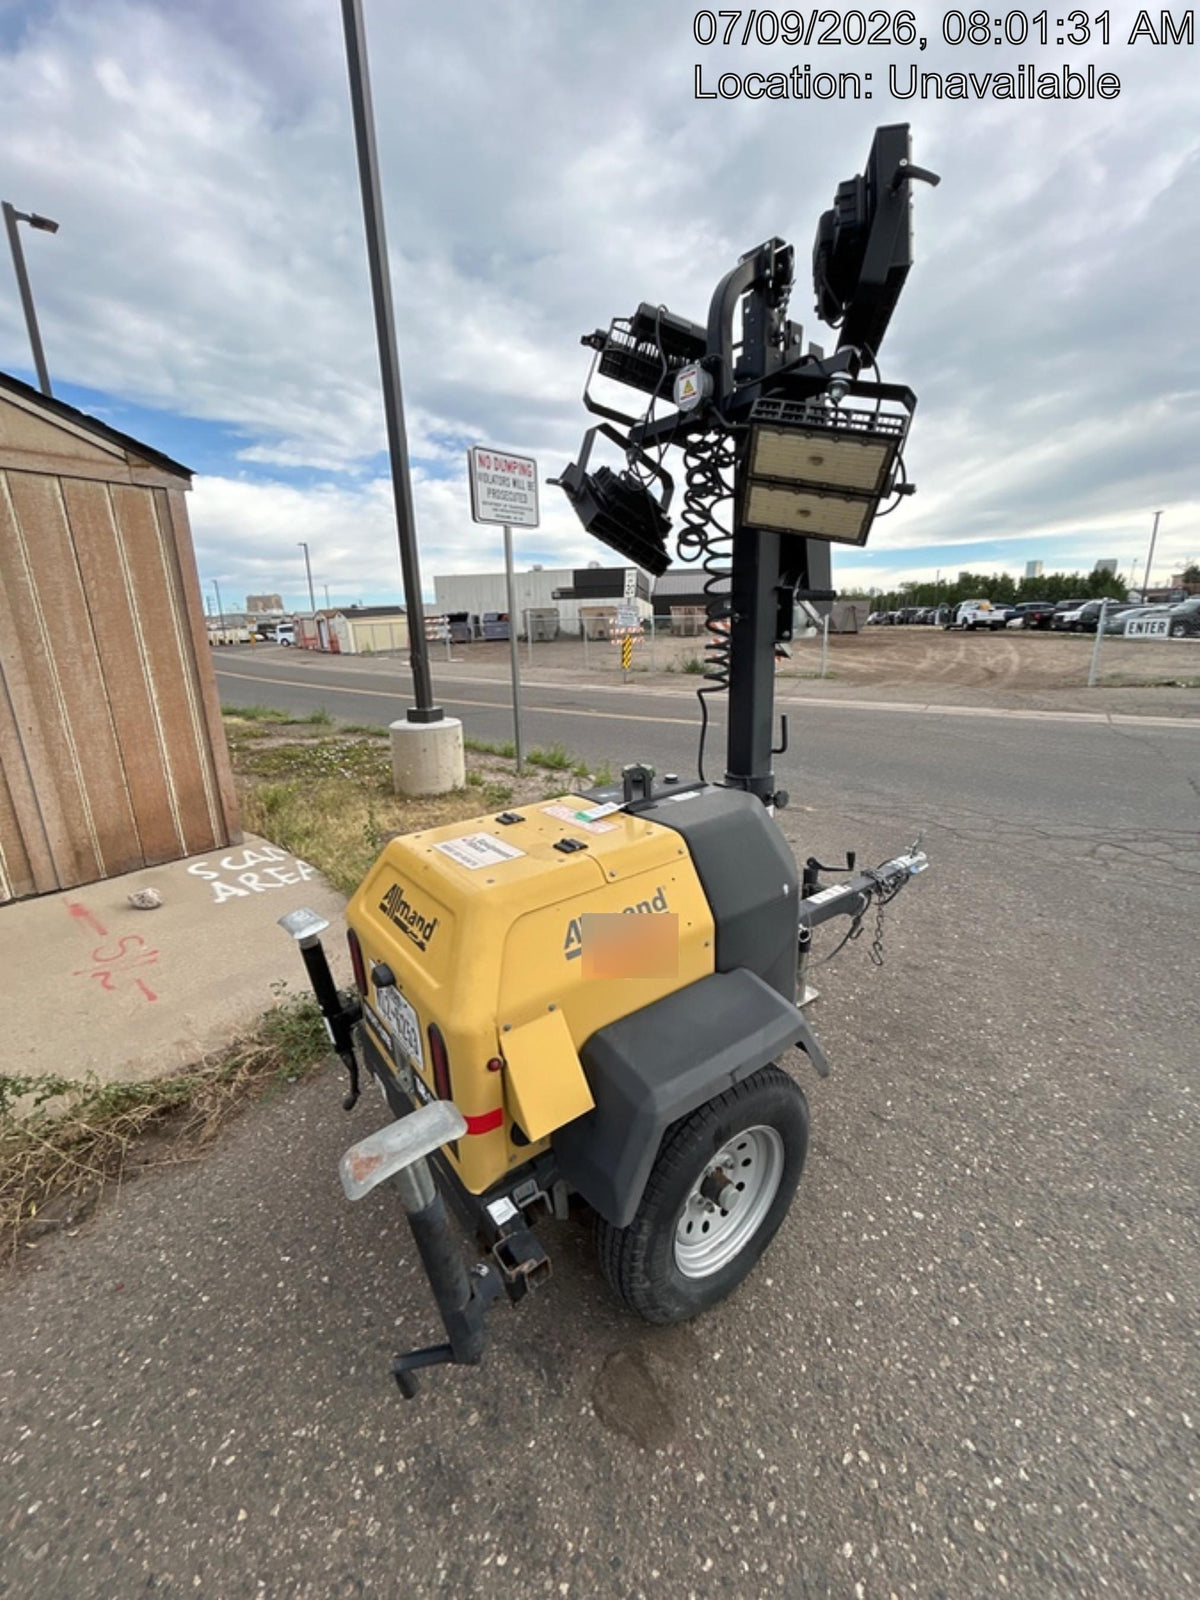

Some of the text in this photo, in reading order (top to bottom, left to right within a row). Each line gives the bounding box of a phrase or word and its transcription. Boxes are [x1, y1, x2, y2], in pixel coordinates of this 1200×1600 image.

[478, 454, 532, 477] NO DUMPING
[1129, 621, 1166, 634] ENTER
[211, 859, 315, 903] AREA
[382, 883, 438, 943] Allmand
